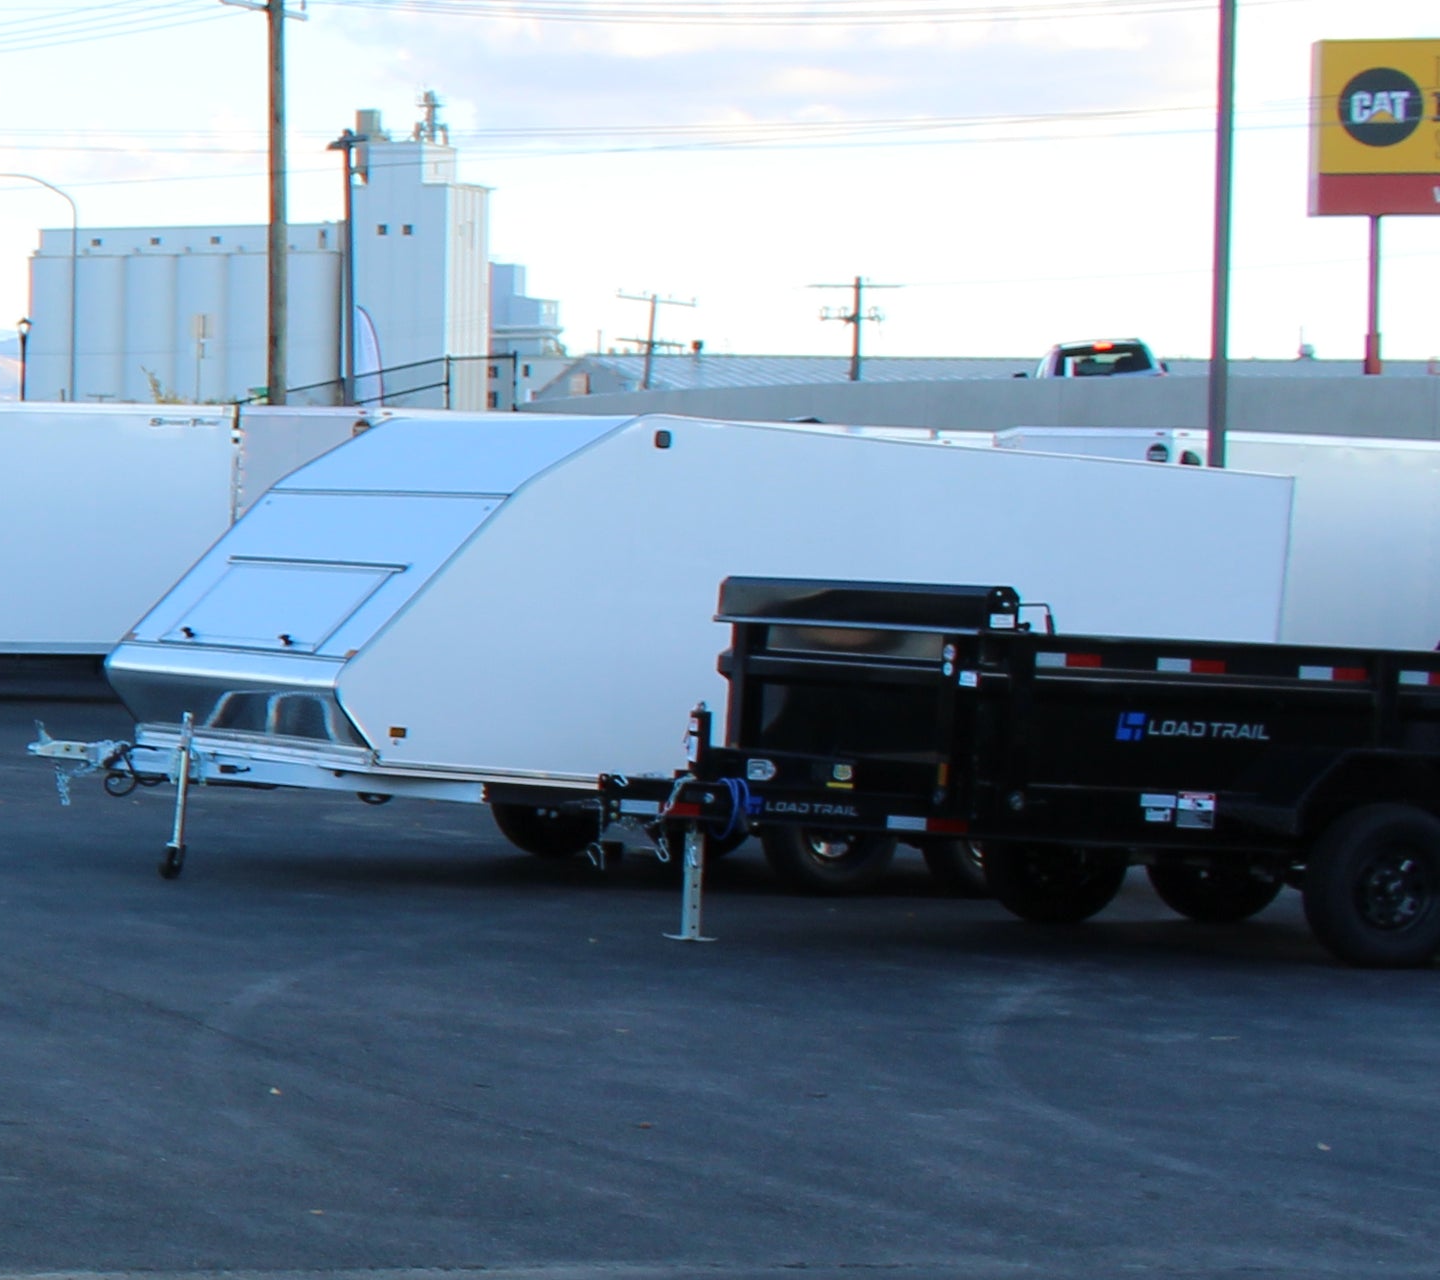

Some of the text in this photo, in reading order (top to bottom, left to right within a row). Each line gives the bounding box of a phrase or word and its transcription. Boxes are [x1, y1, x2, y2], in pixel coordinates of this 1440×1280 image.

[1350, 90, 1411, 125] CAT
[1147, 719, 1206, 738] LOAD
[1210, 722, 1271, 741] TRAIL
[764, 801, 859, 817] LOAD TRAIL
